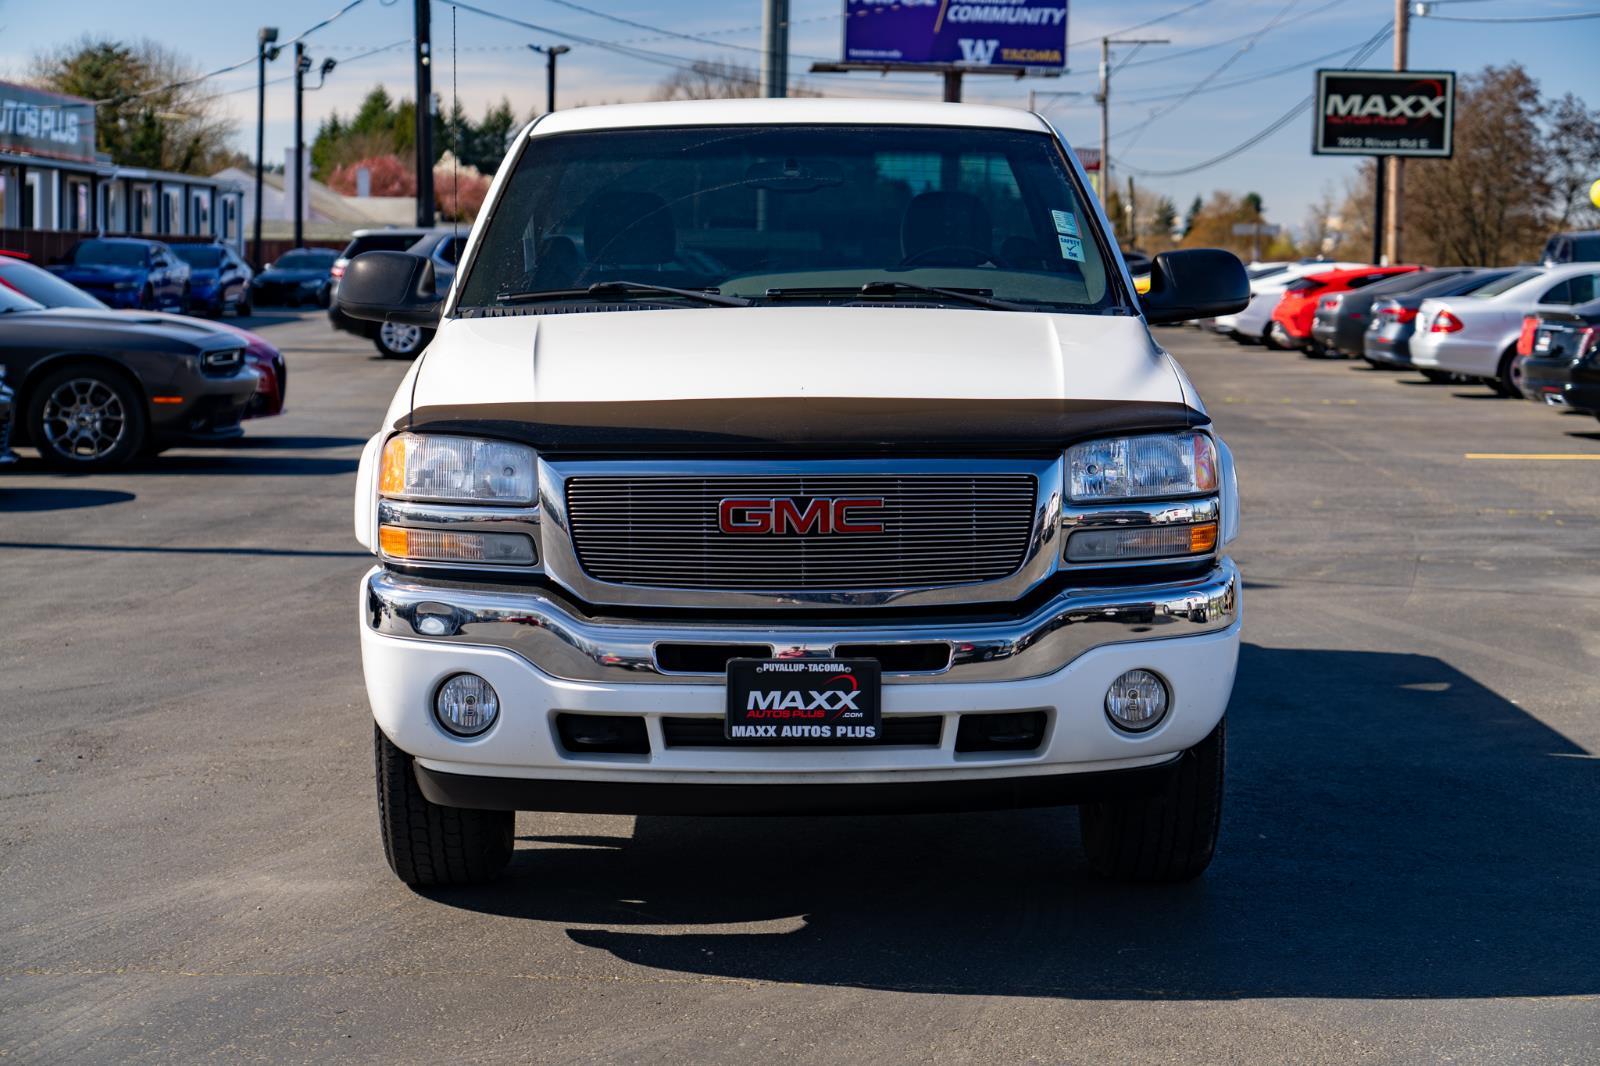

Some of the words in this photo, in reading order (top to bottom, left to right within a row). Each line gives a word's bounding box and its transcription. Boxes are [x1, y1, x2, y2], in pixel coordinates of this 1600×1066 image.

[947, 4, 1066, 25] COMMUNITY
[957, 38, 999, 66] W
[1002, 48, 1062, 63] TACOMA
[1326, 94, 1445, 117] MAXX
[40, 107, 79, 145] PLUS
[719, 498, 885, 534] GMC
[747, 690, 861, 710] MAXX
[747, 709, 791, 719] AUTOS
[792, 709, 825, 719] PLUS
[732, 726, 777, 737] MAXX
[781, 726, 831, 738] AUTOS
[836, 726, 876, 738] PLUS
